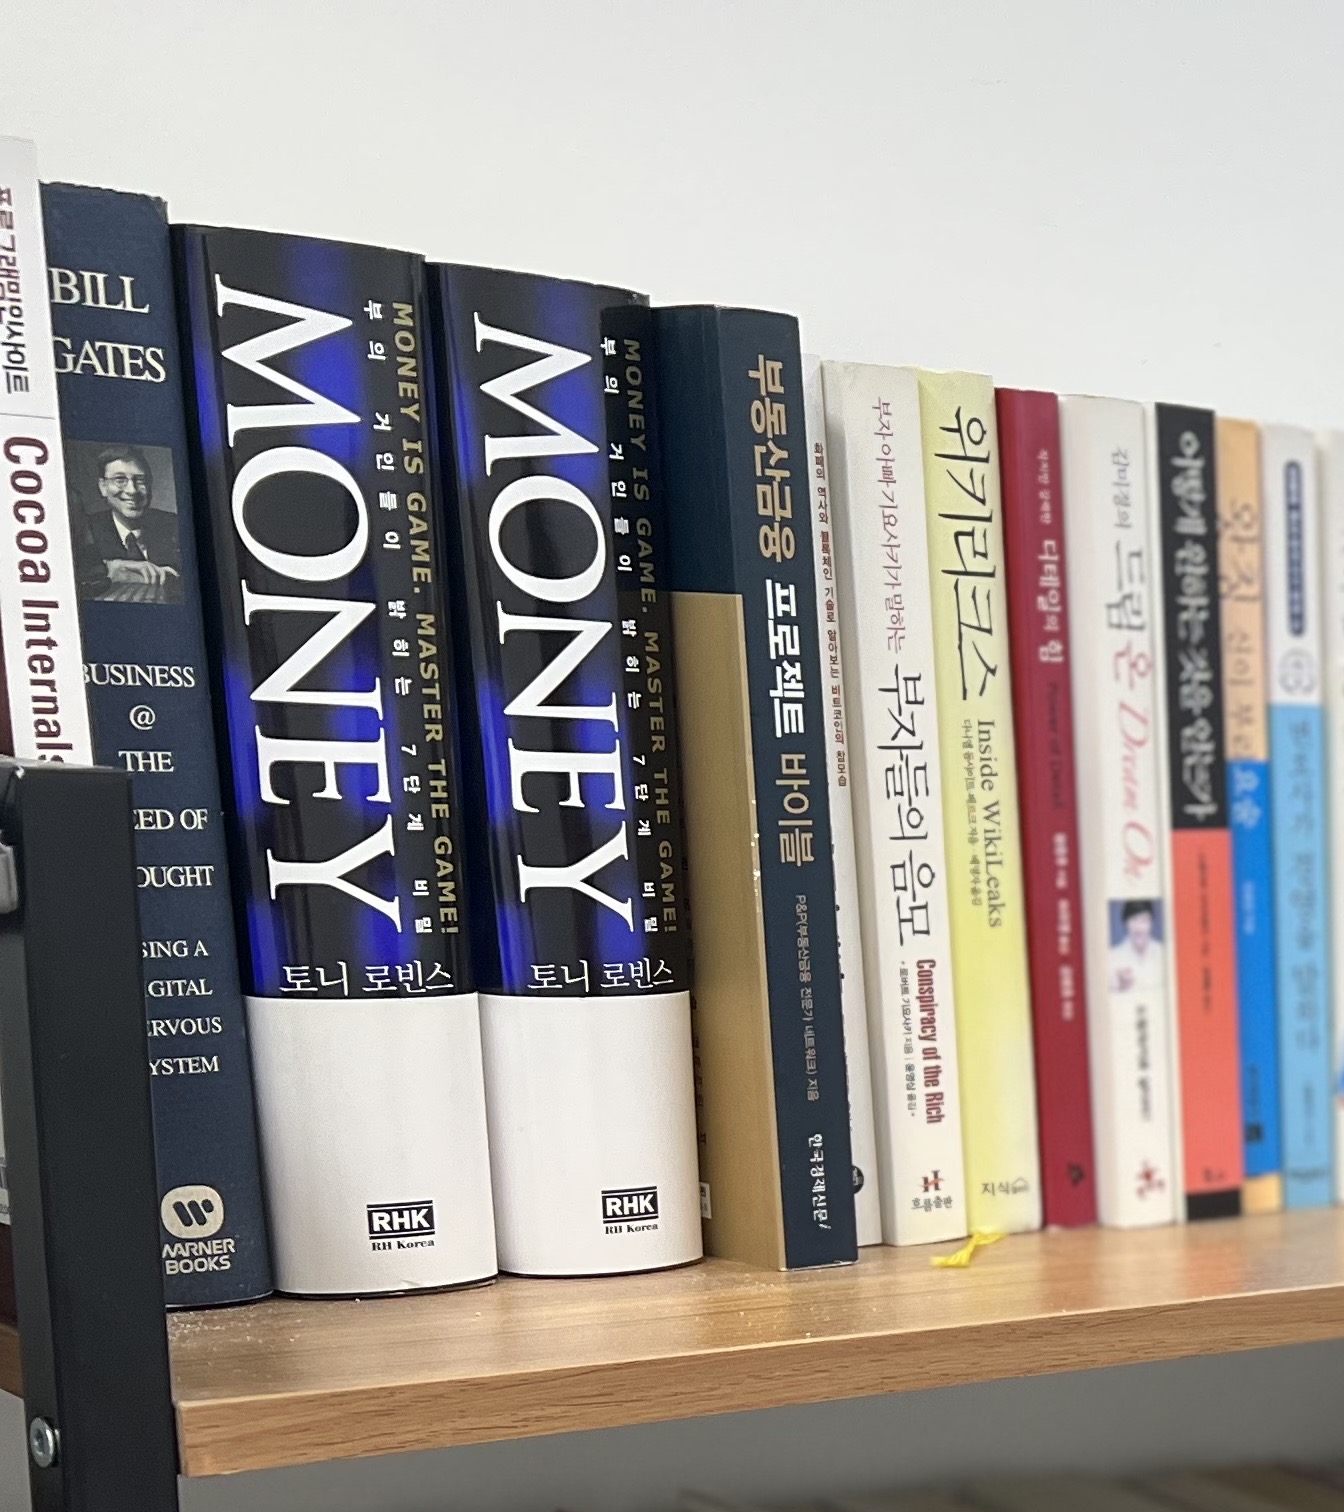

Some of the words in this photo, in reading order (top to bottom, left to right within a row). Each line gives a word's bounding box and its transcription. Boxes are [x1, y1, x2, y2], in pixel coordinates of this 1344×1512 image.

[48, 267, 150, 314] BILL
[53, 338, 168, 383] GATES
[364, 300, 386, 361] 부의
[392, 302, 421, 422] MONEY
[600, 336, 618, 394] 부의
[623, 338, 648, 453] MONEY
[873, 396, 893, 438] 부자
[372, 411, 402, 550] 거인들이
[402, 437, 425, 476] IS
[632, 467, 652, 502] IS
[747, 354, 796, 563] 부동산금융
[876, 444, 897, 487] 아빠
[1111, 446, 1134, 529] 김미경의
[1170, 430, 1207, 536] 어떻게
[2, 436, 50, 586] Cocoa
[608, 443, 633, 573] 거인들이
[879, 490, 904, 591] 기요사키가
[406, 491, 434, 596] GAME.
[635, 516, 657, 615] GAME.
[820, 530, 834, 581] 블록체인
[933, 405, 998, 702] 위키리크스
[214, 273, 403, 934] MONEY
[824, 586, 837, 624] 기술로
[1037, 539, 1063, 633] 디테일의
[1106, 540, 1147, 632] 드림
[1174, 539, 1212, 642] 원하는
[387, 600, 413, 696] 밝히는
[473, 311, 634, 933] MONEY
[884, 593, 907, 655] 말하는
[1038, 639, 1065, 664] 힘
[20, 599, 73, 764] Internals
[81, 662, 196, 689] BUSINESS
[415, 612, 444, 744] MASTER
[620, 618, 643, 711] 밝히는
[765, 577, 806, 738] 프로젝트
[1112, 640, 1153, 691] 온
[129, 704, 157, 731] @
[643, 630, 666, 754] MASTER
[119, 750, 175, 774] THE
[877, 663, 930, 841] 부자들의
[976, 719, 999, 793] Inside
[1118, 698, 1152, 812] Dream
[1180, 717, 1220, 821] 얻는가
[180, 810, 208, 830] OF
[427, 757, 451, 820] THE
[653, 767, 672, 827] THE
[775, 752, 816, 867] 바이블
[432, 834, 459, 936] GAME!
[658, 838, 678, 933] GAME!
[981, 798, 1007, 929] WikiLeaks
[412, 878, 433, 935] 비밀
[641, 880, 659, 933] 비밀
[889, 849, 936, 948] 음모
[193, 940, 209, 957] A
[281, 960, 350, 996] 토니
[362, 959, 455, 995] 로빈스
[528, 959, 590, 993] 토니
[602, 957, 676, 991] 로빈스
[800, 985, 815, 1022] 전문가
[916, 959, 938, 1042] Conspiracy
[921, 1046, 941, 1062] of
[923, 1065, 942, 1090] the
[807, 1079, 820, 1101] 지음
[925, 1091, 946, 1126] Rich
[604, 1194, 657, 1219] RHK
[808, 1132, 829, 1221] 한국경제신문
[371, 1241, 393, 1252] RH
[396, 1237, 436, 1250] Korea
[372, 1209, 431, 1236] RHK
[625, 1221, 659, 1233] Korea
[166, 1256, 231, 1275] BOOKS
